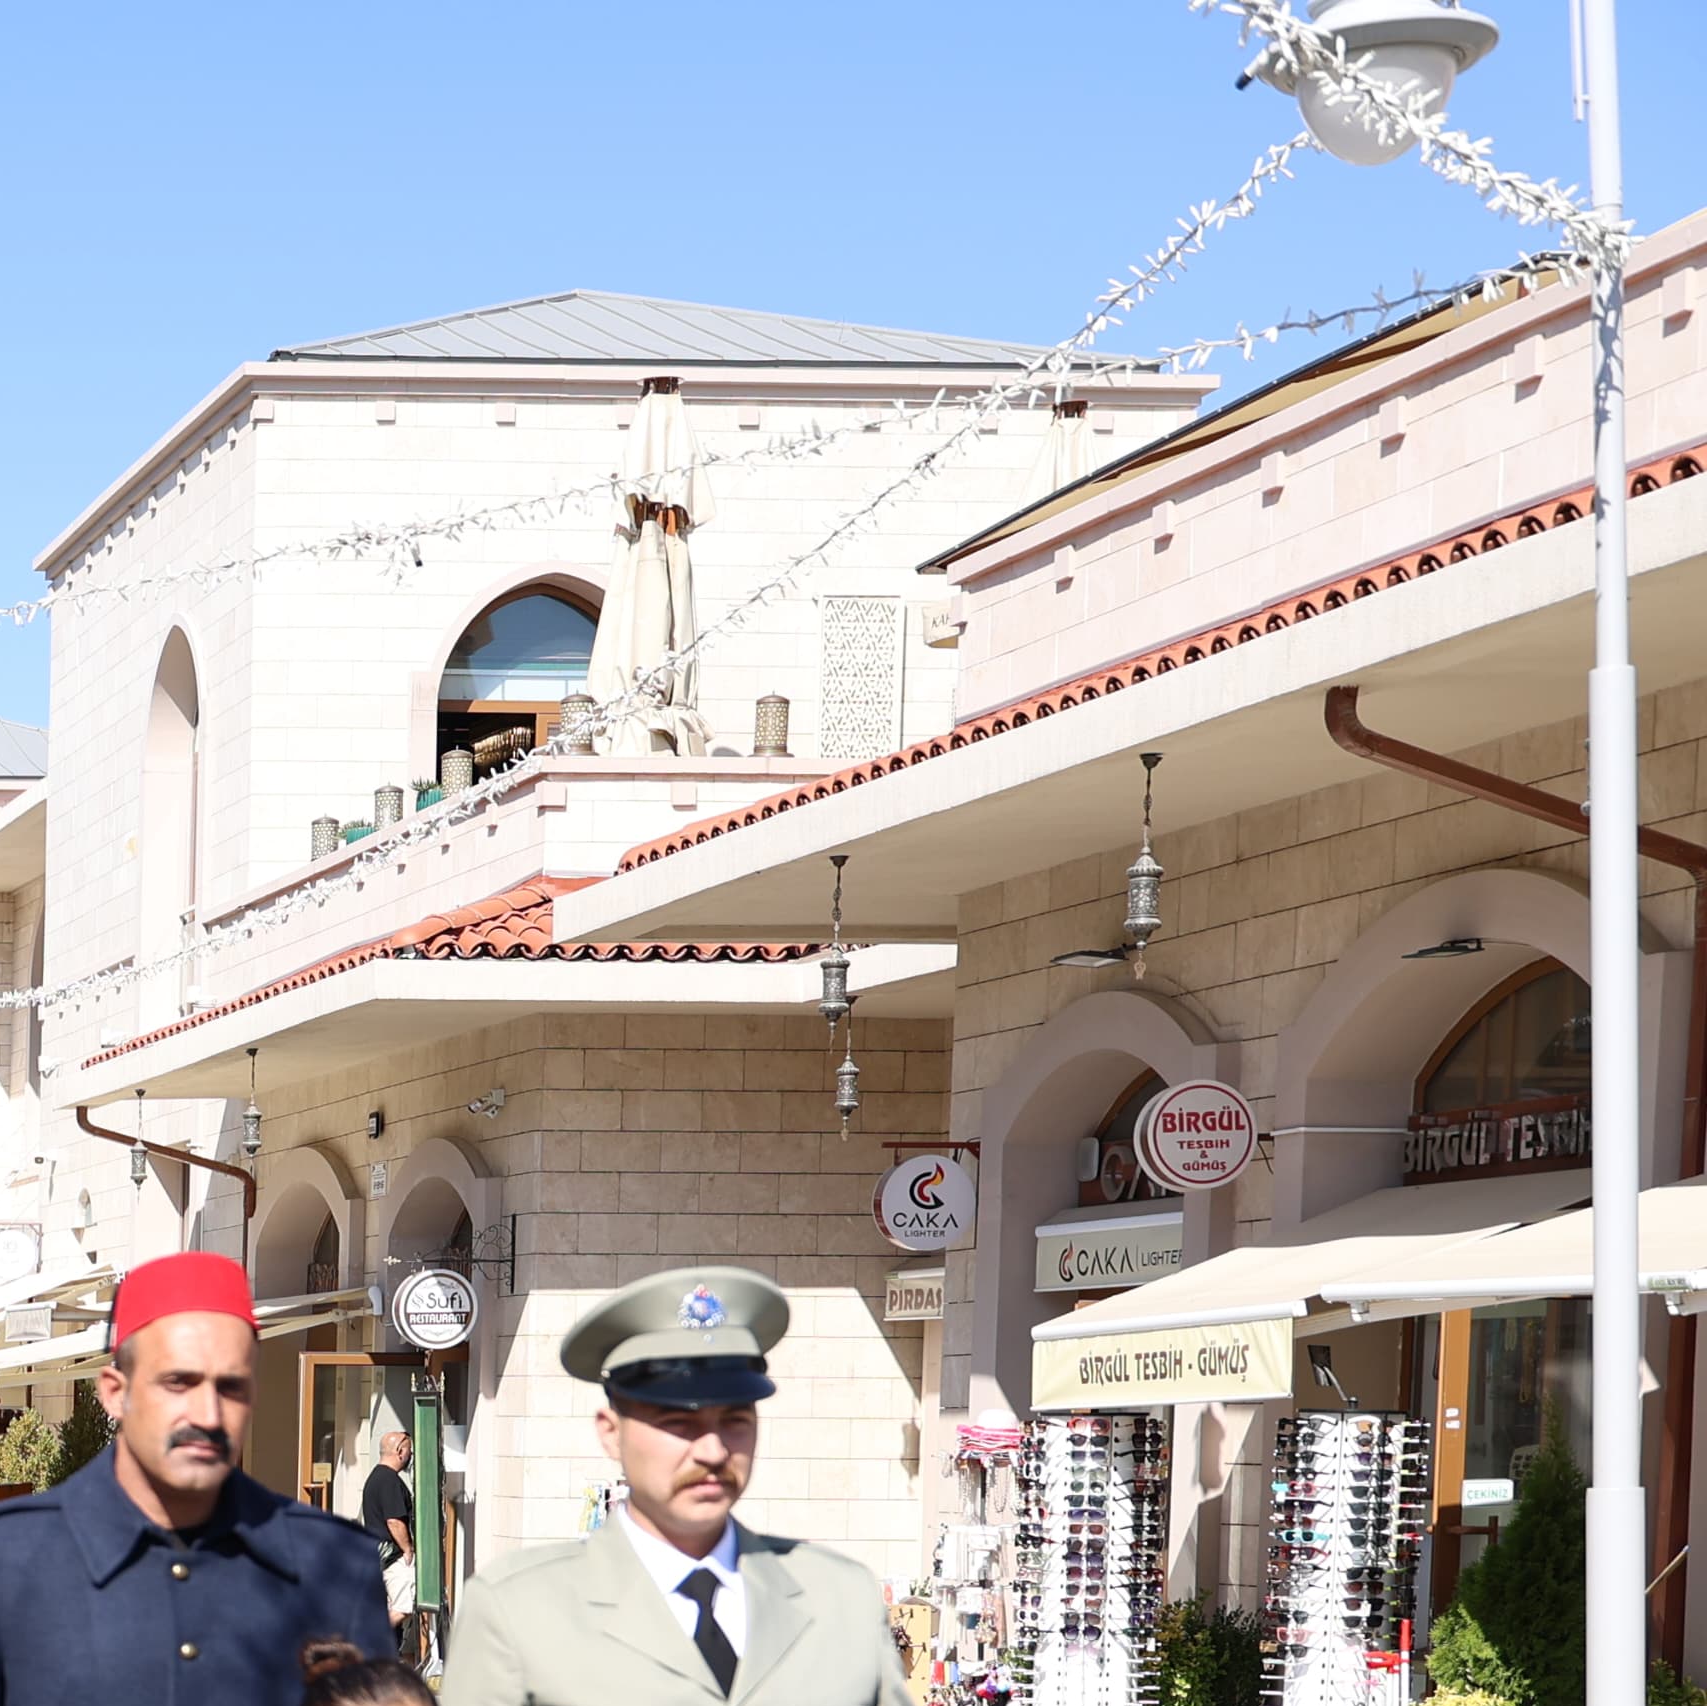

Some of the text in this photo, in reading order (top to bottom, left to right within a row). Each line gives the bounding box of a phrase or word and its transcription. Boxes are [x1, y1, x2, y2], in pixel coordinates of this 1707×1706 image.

[1162, 1106, 1246, 1134] BİRGÜL
[1200, 1151, 1208, 1159] &
[1182, 1160, 1228, 1172] GÜMÜŞ
[893, 1212, 959, 1229] CAKA
[904, 1230, 946, 1238] LIGHTER
[427, 1291, 463, 1309] Sufi
[410, 1313, 467, 1324] RESTAURANT
[1079, 1348, 1130, 1386] BİRGÜL
[1135, 1344, 1183, 1382] TESBİH
[1197, 1339, 1250, 1383] GÜMÜŞ
[1467, 1488, 1508, 1501] ÇEKİNİZ
